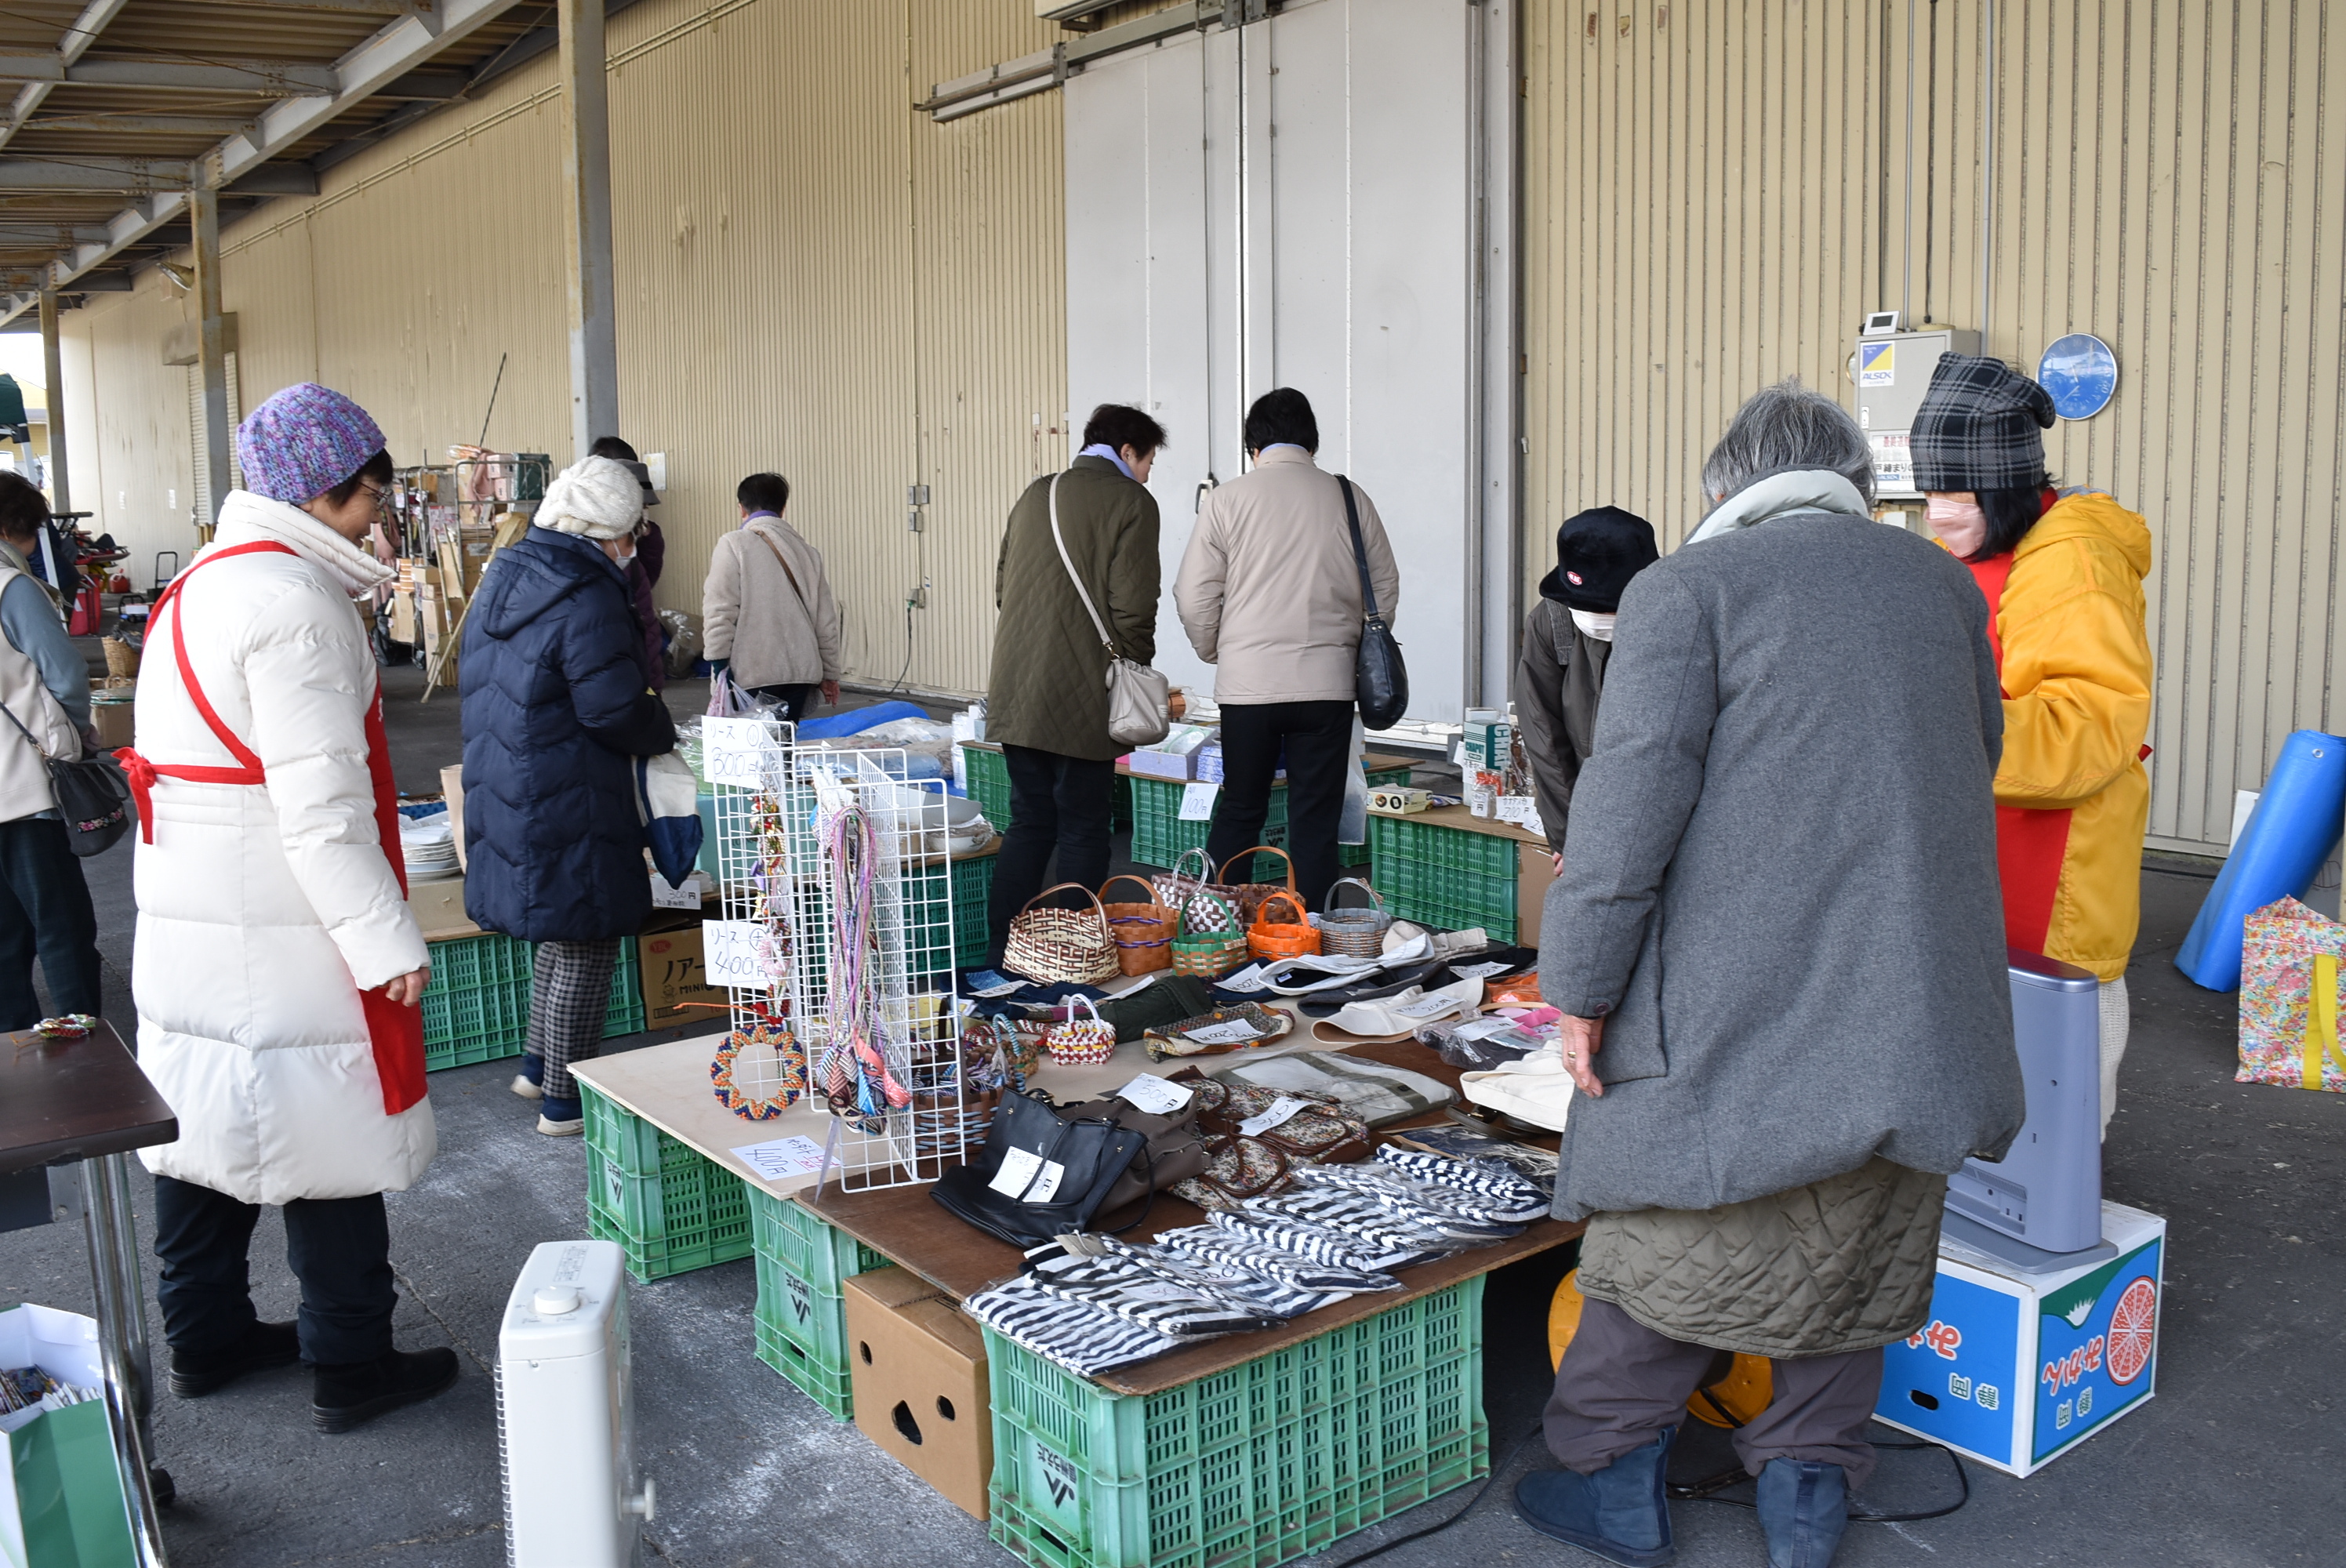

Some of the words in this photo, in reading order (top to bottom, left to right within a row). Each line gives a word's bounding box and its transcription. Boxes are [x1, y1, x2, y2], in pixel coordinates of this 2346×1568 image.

[1862, 372, 1892, 380] ALSOK
[710, 928, 739, 946] リース
[2042, 1334, 2104, 1396] みかん
